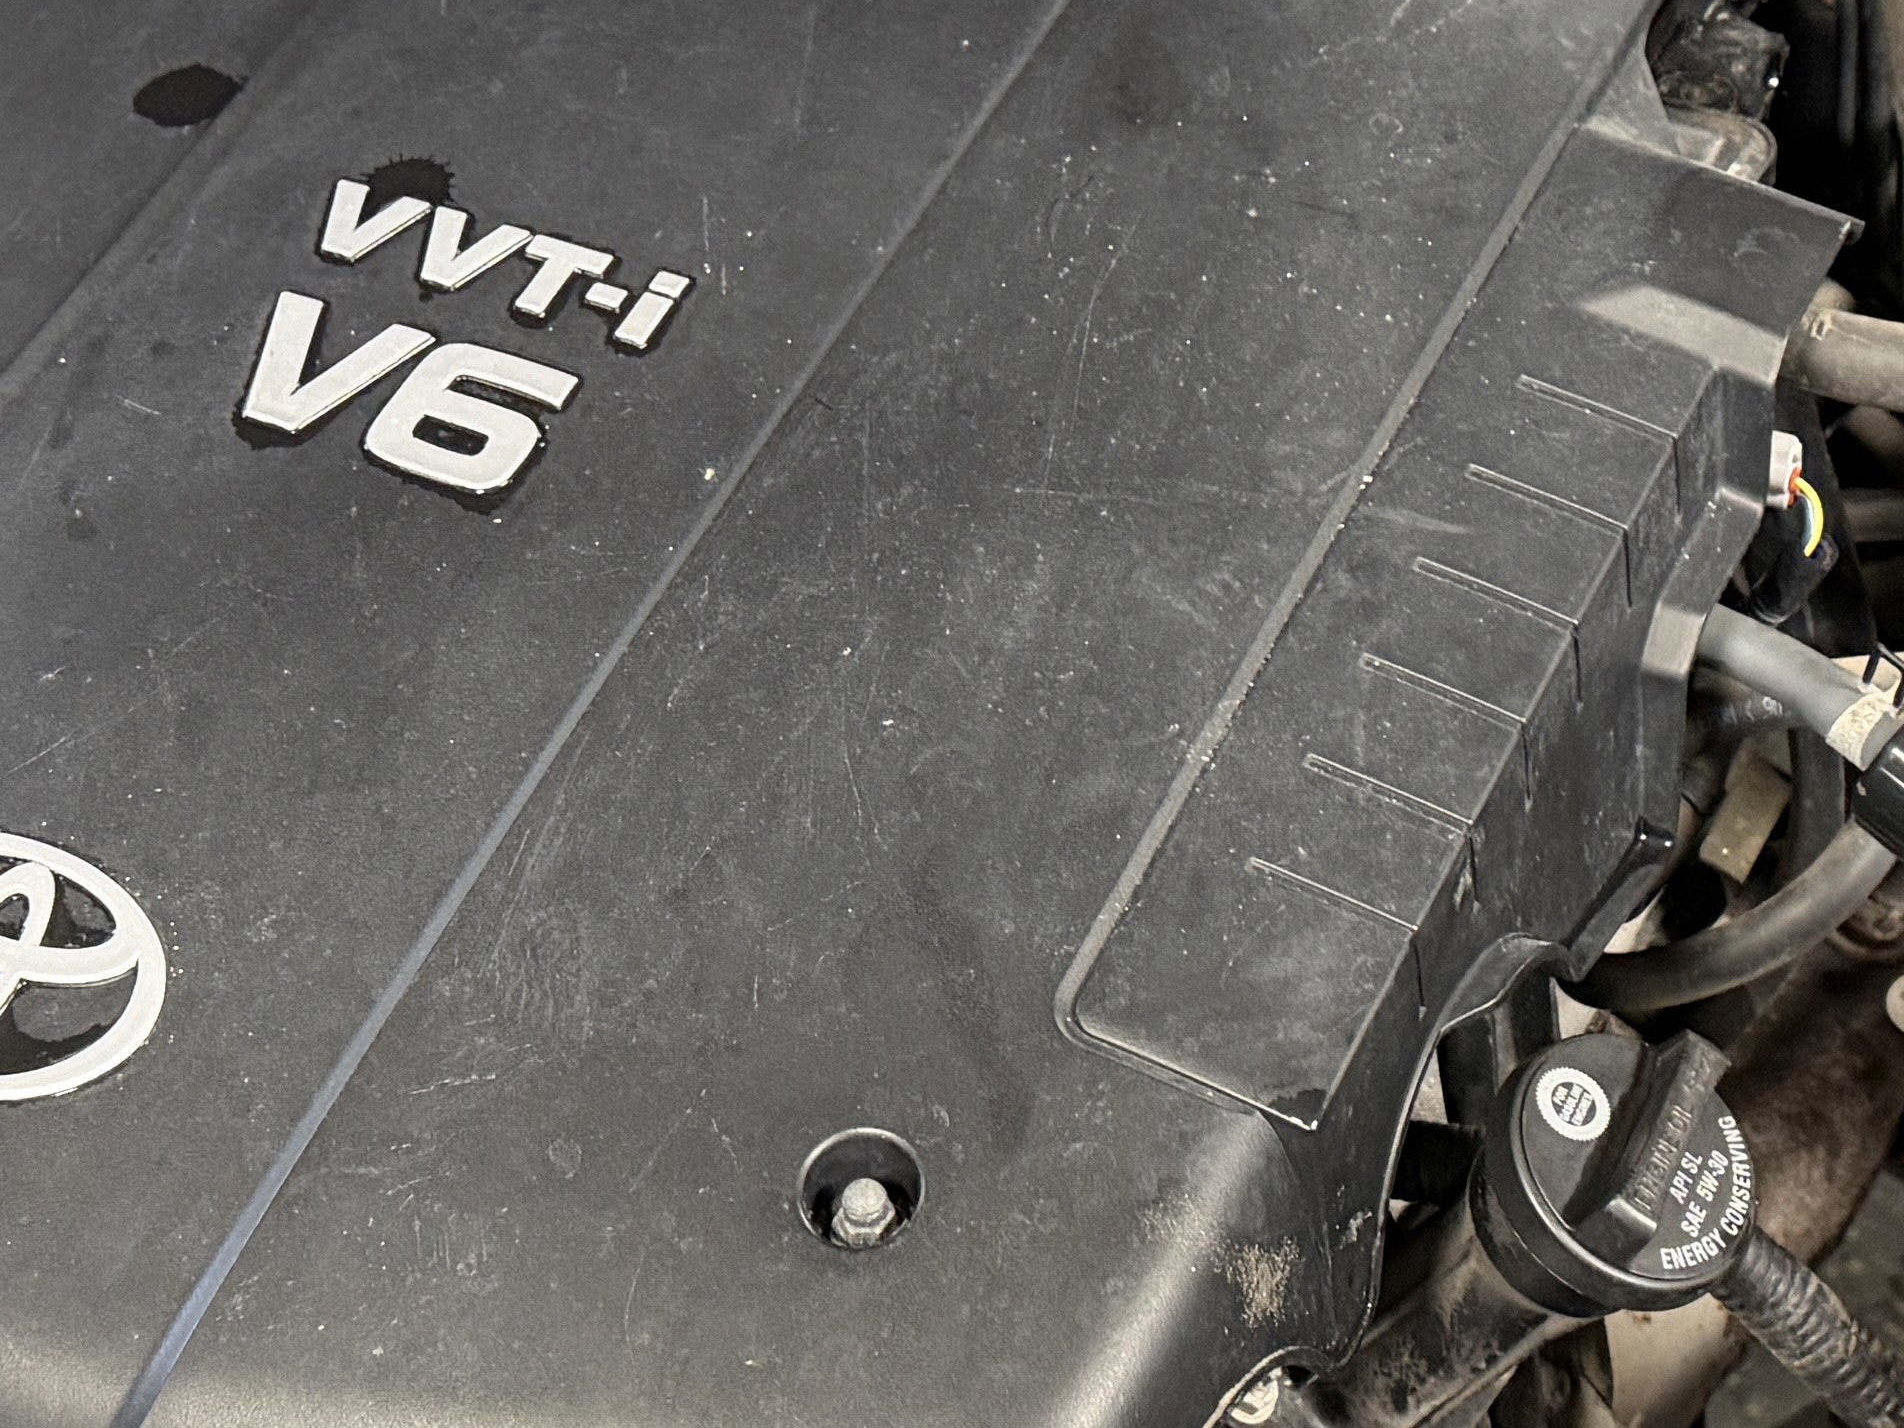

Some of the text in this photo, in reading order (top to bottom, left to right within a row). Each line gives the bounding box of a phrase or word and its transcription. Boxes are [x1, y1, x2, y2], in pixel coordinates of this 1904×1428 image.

[318, 177, 691, 352] VVT-i
[240, 289, 581, 495] V6
[1659, 1115, 1752, 1270] ENERGY CONSERVING
[1669, 1151, 1703, 1205] API SL
[1680, 1149, 1729, 1238] SAE 5W-30
